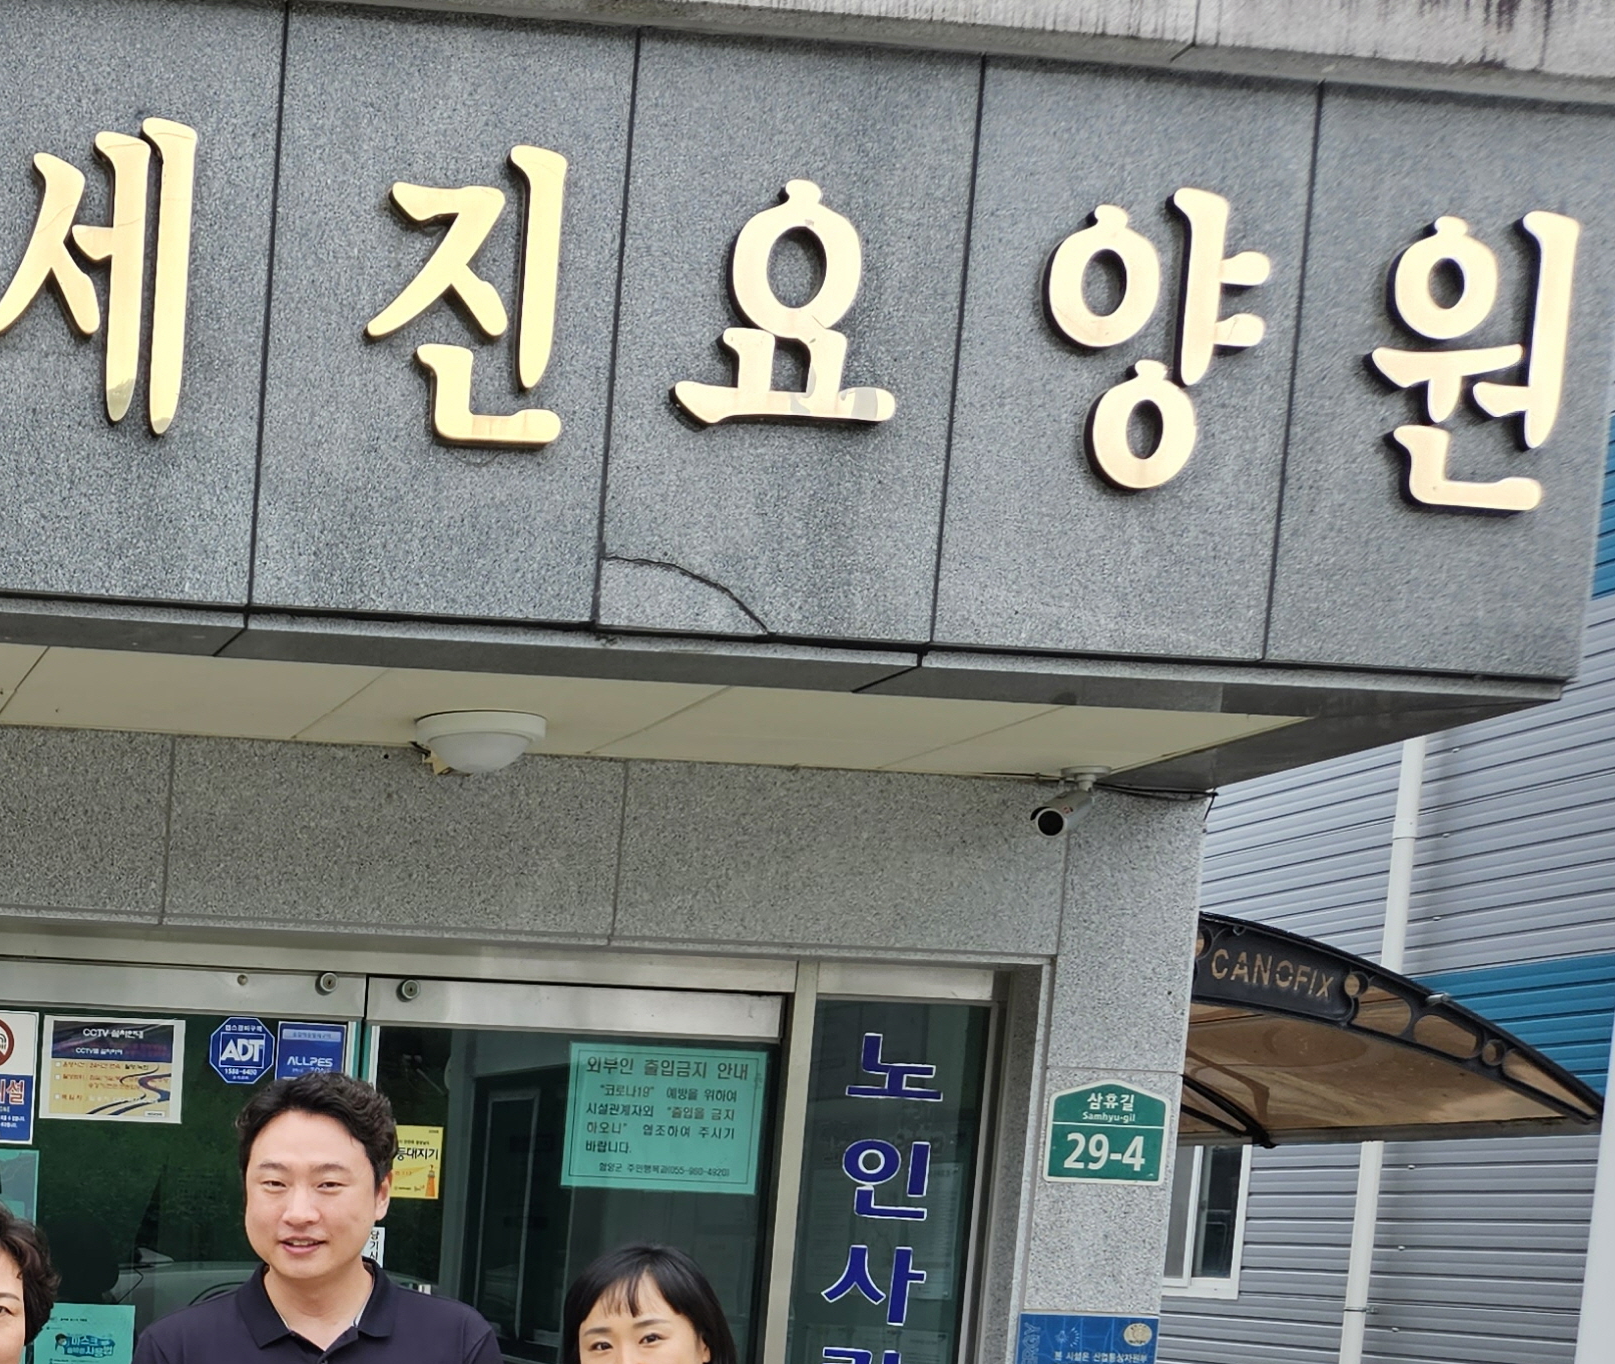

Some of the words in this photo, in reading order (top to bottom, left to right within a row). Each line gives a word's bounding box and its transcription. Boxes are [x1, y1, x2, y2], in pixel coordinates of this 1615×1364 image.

[1211, 947, 1336, 999] CANOFIX
[83, 1028, 109, 1037] CCTV
[221, 1038, 264, 1062] ADT
[287, 1056, 334, 1067] ALLPES
[587, 1056, 634, 1075] 외부인
[644, 1059, 707, 1079] 출입금지
[717, 1063, 748, 1081] 안내
[666, 1086, 698, 1101] 예방을
[704, 1089, 737, 1103] 위하여
[1087, 1092, 1135, 1112] 삼휴길
[586, 1102, 654, 1118] 시설관계자외
[711, 1108, 735, 1121] 금지
[1082, 1111, 1136, 1123] Samhyu-gil
[643, 1124, 691, 1138] 협조하여
[698, 1126, 735, 1140] 주시기
[585, 1140, 632, 1154] 바랍니다.
[1063, 1132, 1145, 1171] 29-4
